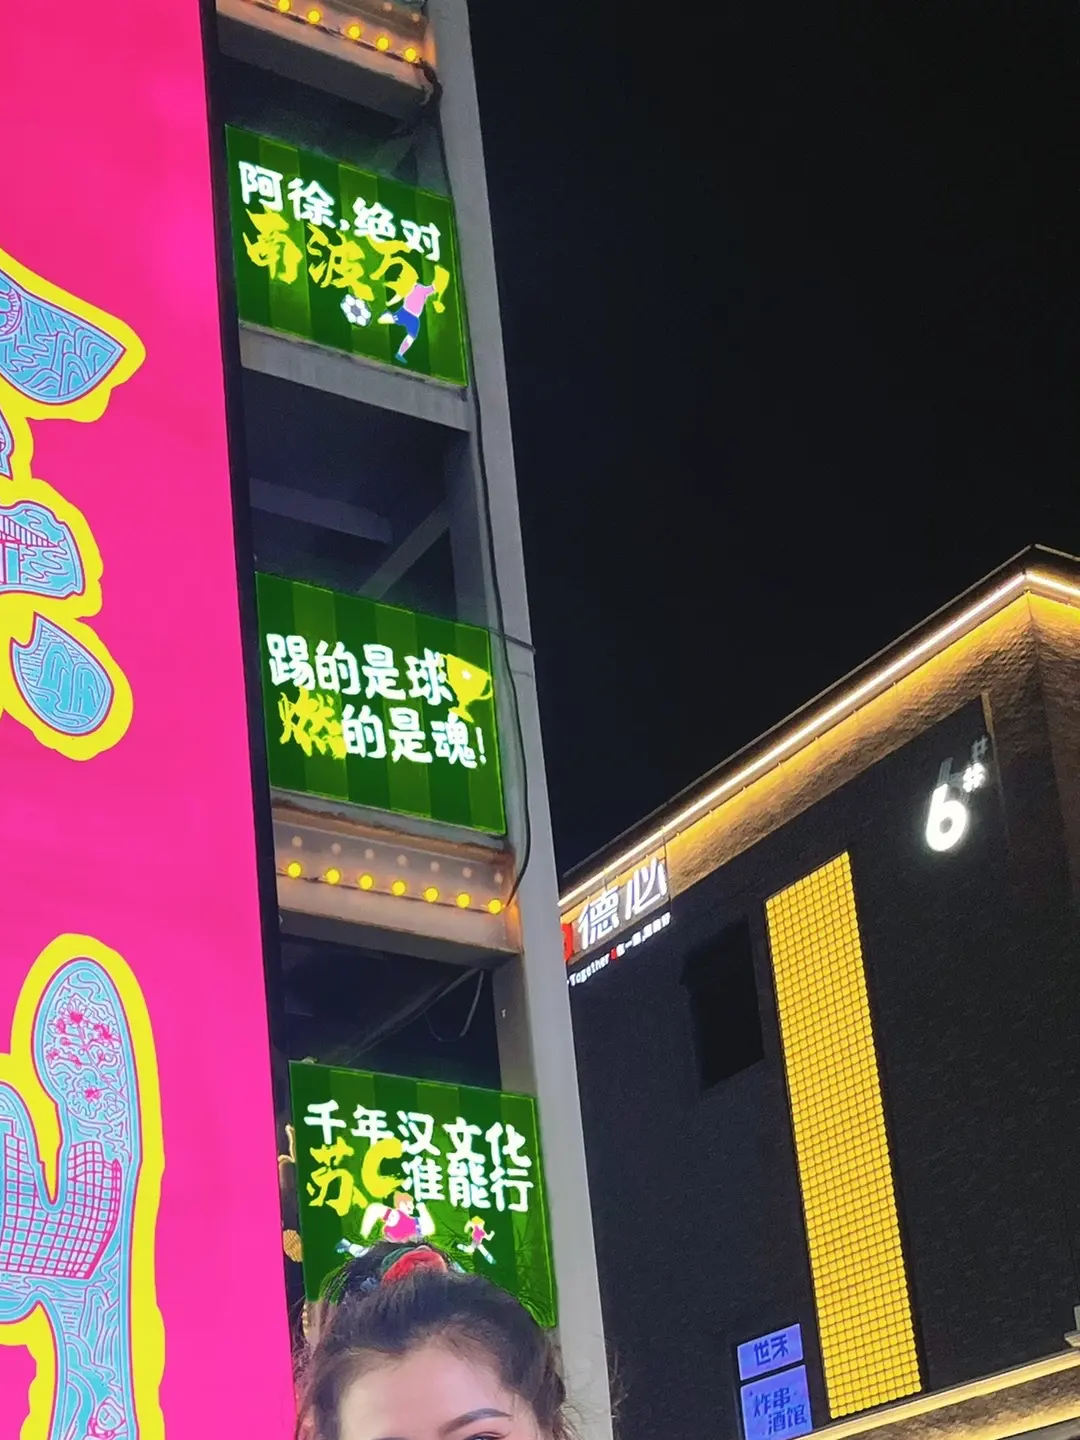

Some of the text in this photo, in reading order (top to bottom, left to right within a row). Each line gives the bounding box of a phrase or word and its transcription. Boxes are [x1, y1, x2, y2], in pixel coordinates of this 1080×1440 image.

[266, 632, 454, 706] 踢的是球
[577, 856, 668, 950] 德必
[303, 1099, 532, 1168] 千年汉文化
[753, 1387, 791, 1418] 炸串
[767, 1403, 808, 1436] 酒馆
